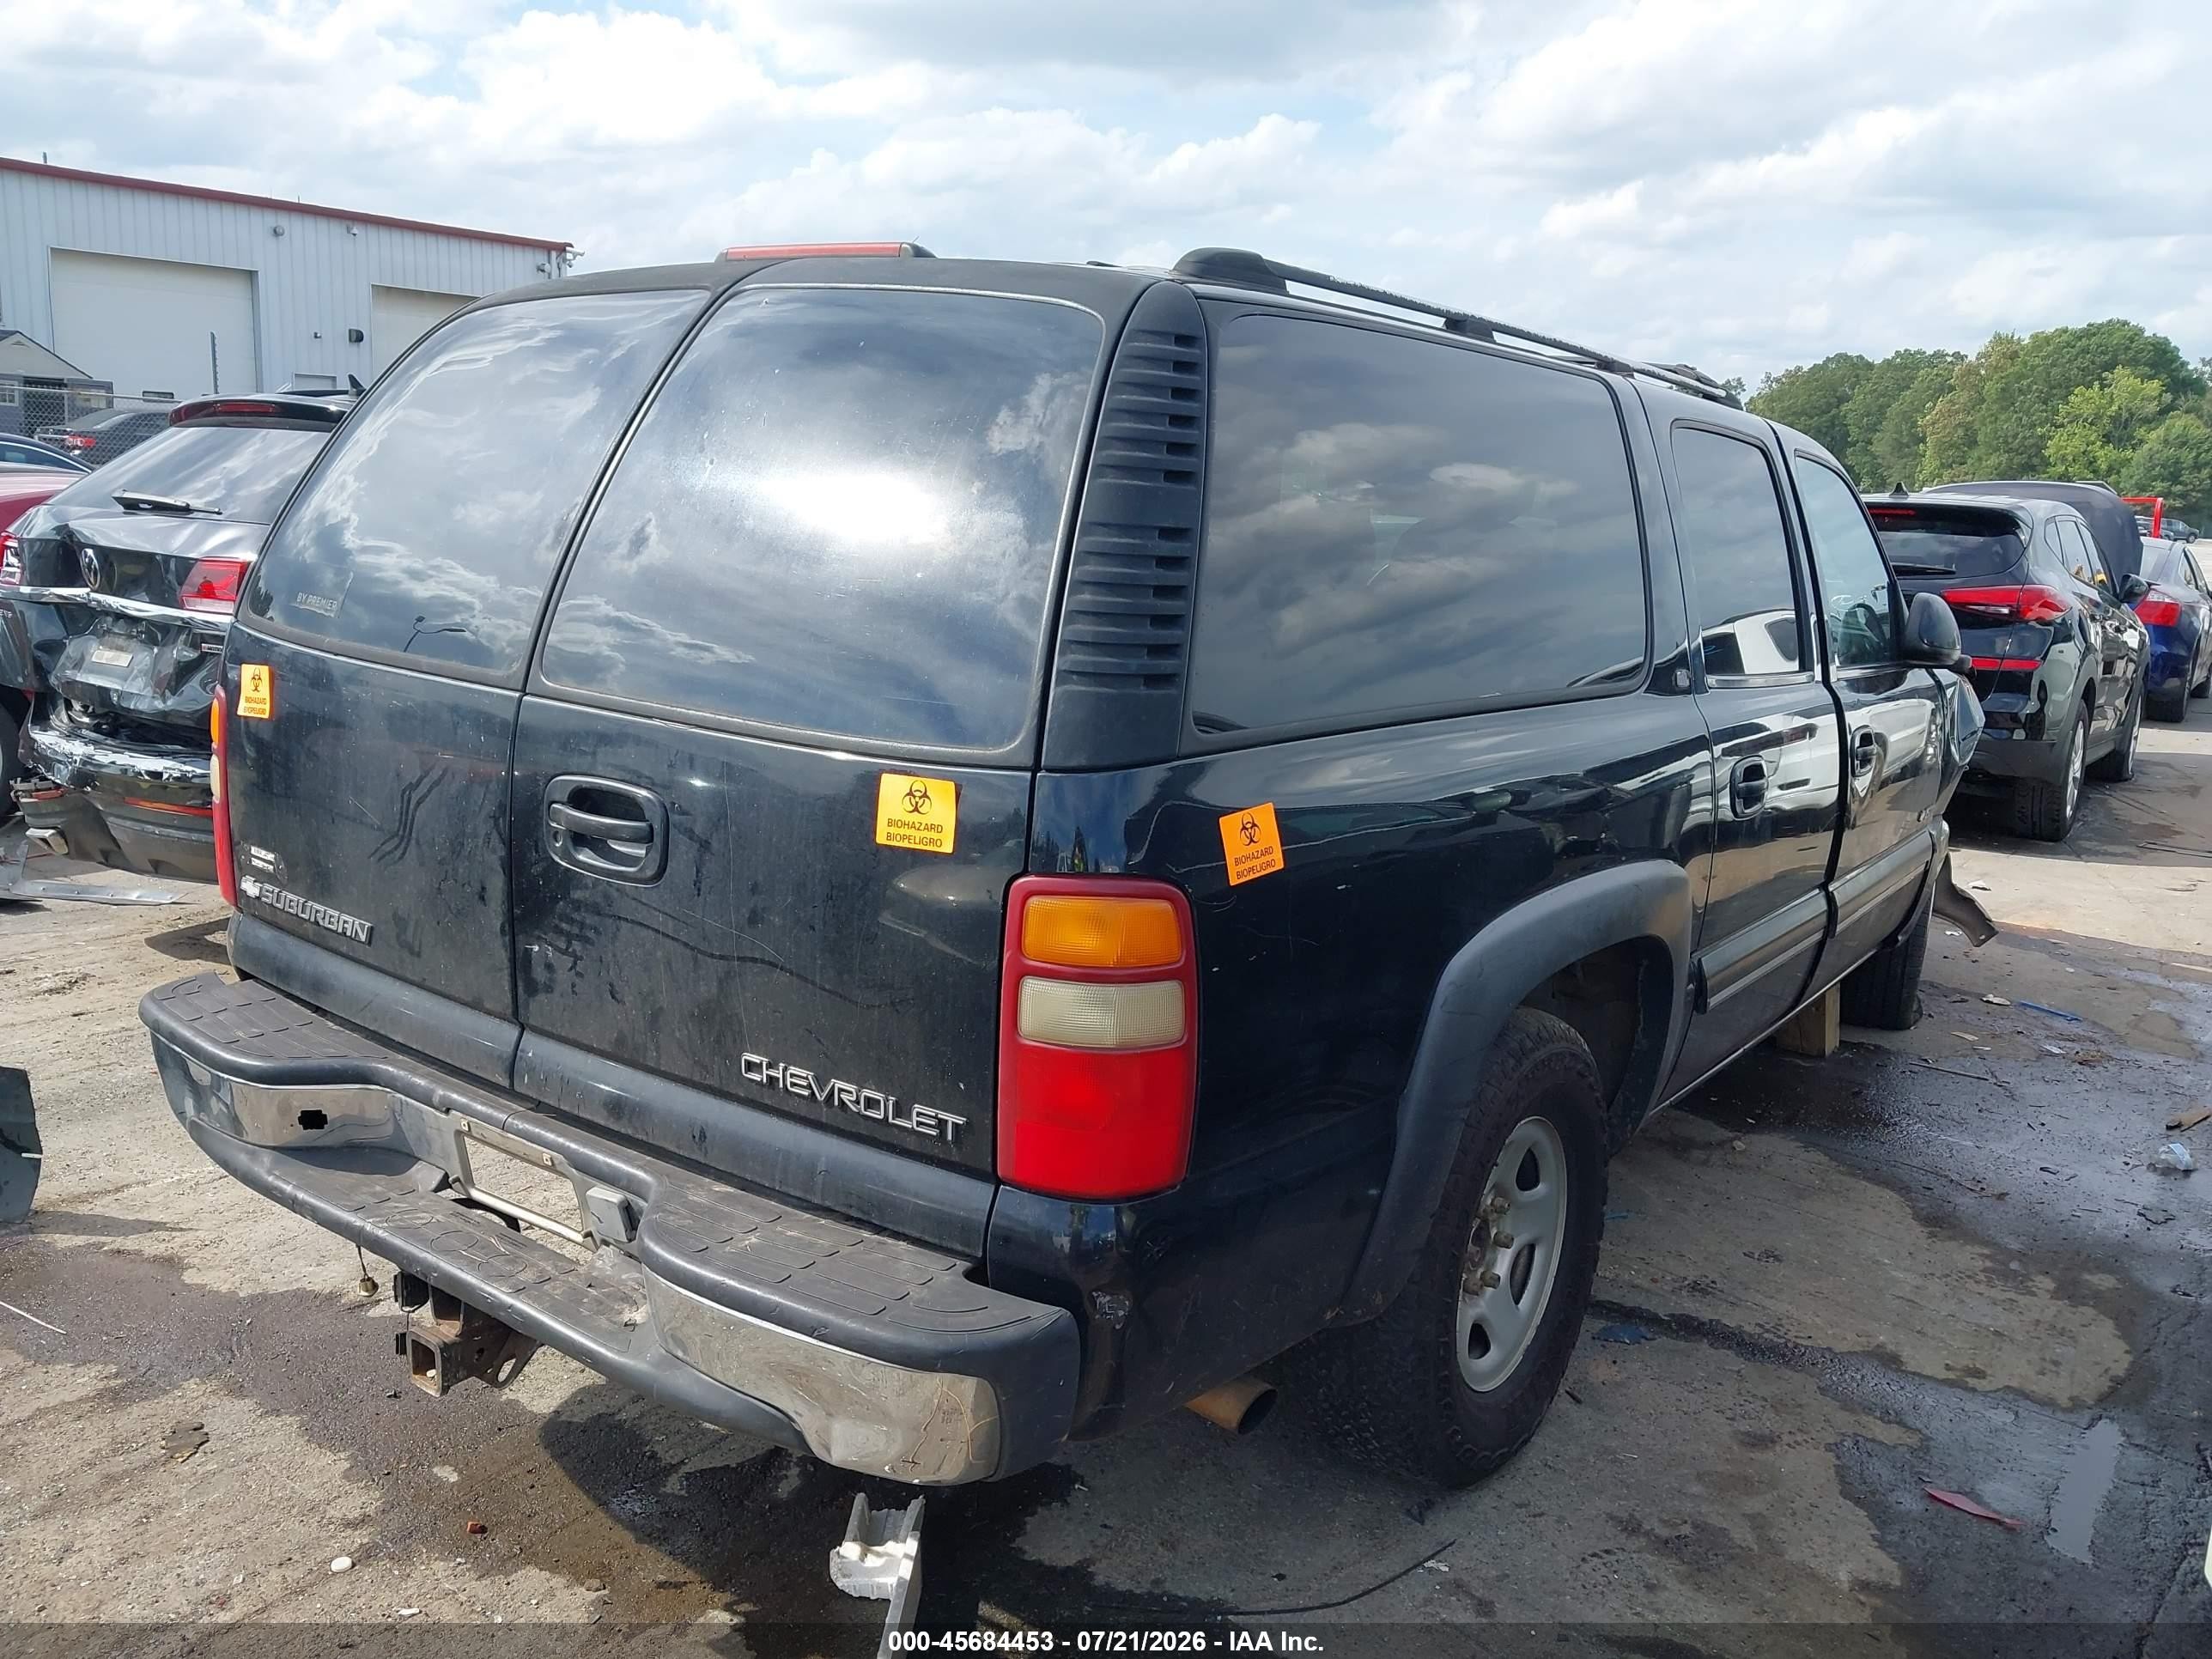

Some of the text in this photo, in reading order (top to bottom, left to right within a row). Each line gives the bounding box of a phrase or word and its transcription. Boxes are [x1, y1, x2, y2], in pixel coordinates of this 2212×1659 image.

[296, 592, 307, 602] BY
[887, 817, 944, 834] BIOHAZARD
[886, 831, 943, 848] BIOPELIGRO
[1234, 846, 1274, 866] BIOHAZARD
[1236, 859, 1276, 880] BIOPELIGRO
[260, 883, 374, 945] SUBURBAN
[741, 1053, 968, 1141] CHEVROLET
